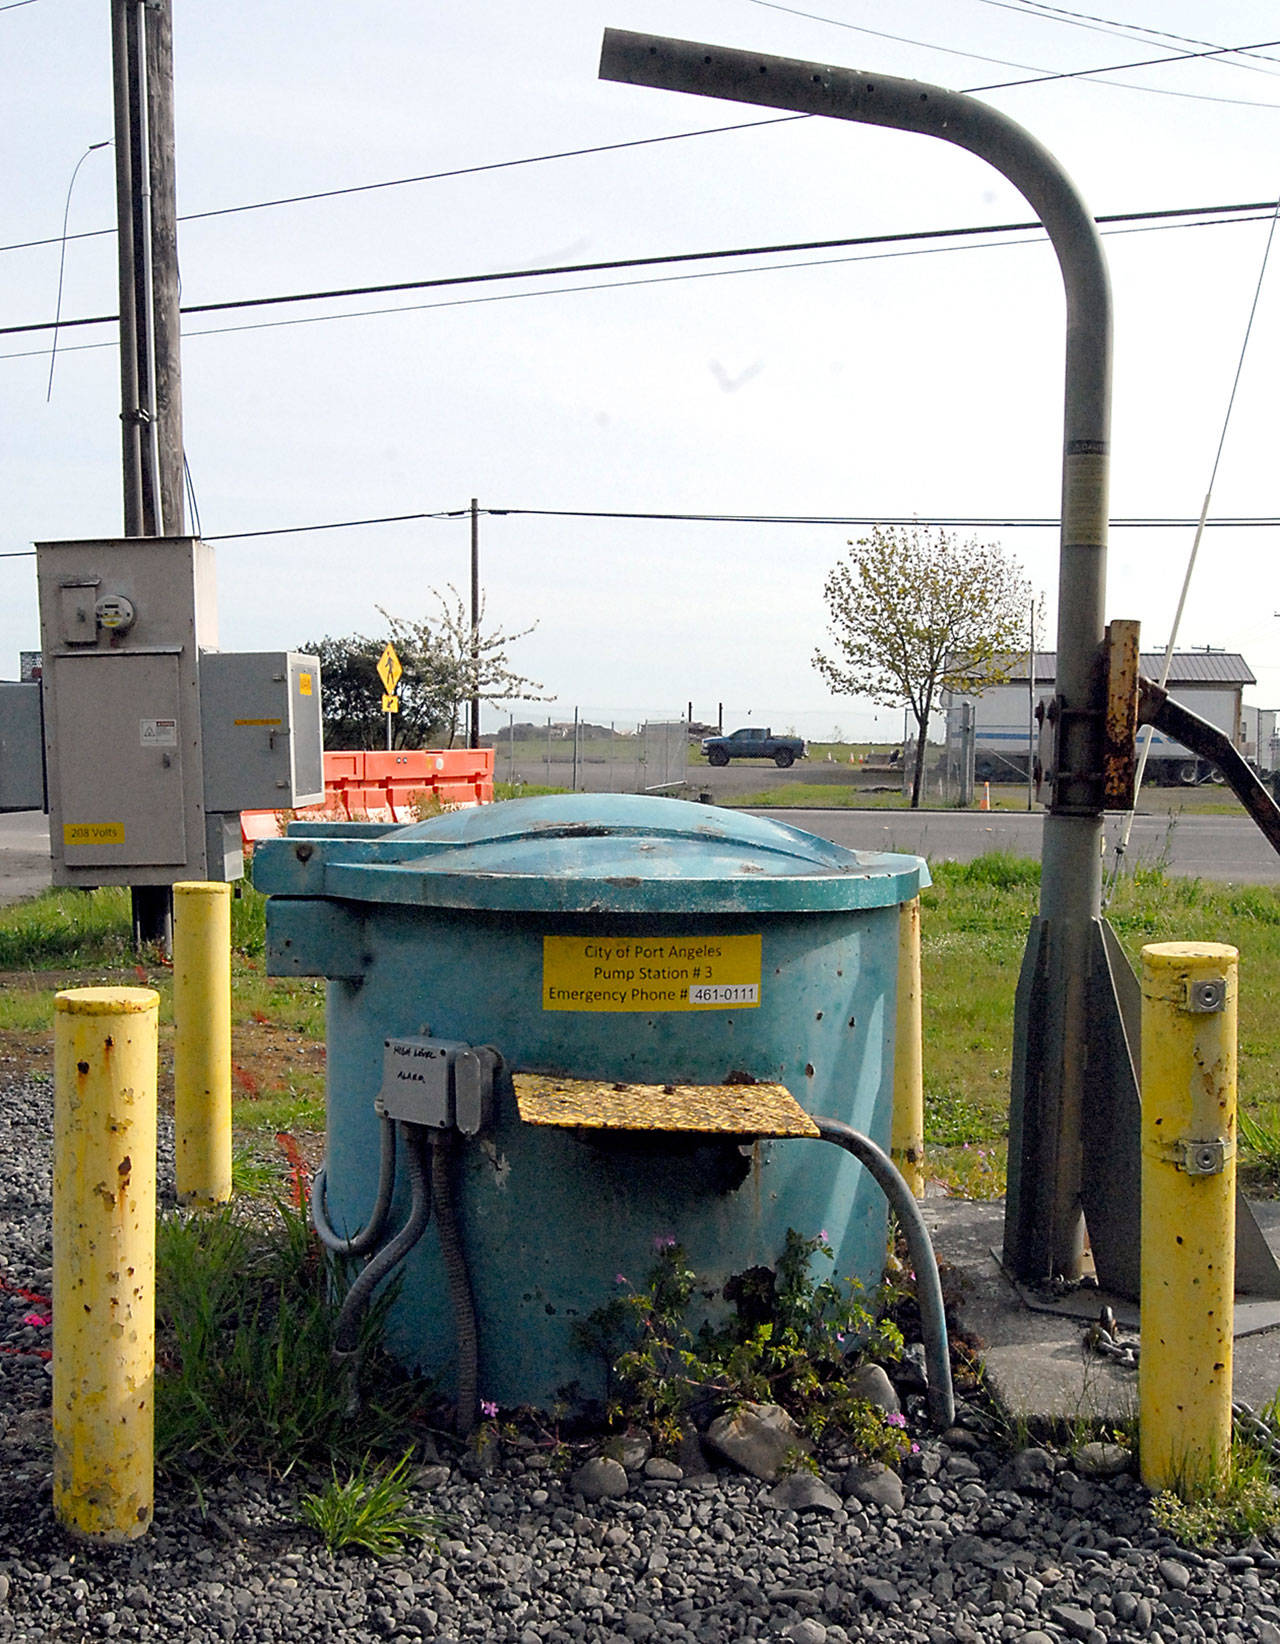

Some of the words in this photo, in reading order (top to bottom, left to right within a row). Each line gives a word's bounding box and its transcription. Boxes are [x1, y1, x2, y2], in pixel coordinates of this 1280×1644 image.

[71, 828, 90, 838] 208
[92, 827, 118, 838] Volts
[584, 945, 611, 960] City
[616, 945, 631, 958] of
[634, 945, 664, 958] Port
[668, 944, 722, 960] Angeles
[593, 967, 635, 981] Pump
[639, 967, 689, 979] Station
[692, 967, 701, 978] #
[705, 966, 713, 978] 3
[549, 987, 627, 1003] Emergency
[631, 988, 676, 1001] Phone
[679, 988, 688, 1000] #
[695, 988, 754, 1000] 461-0111
